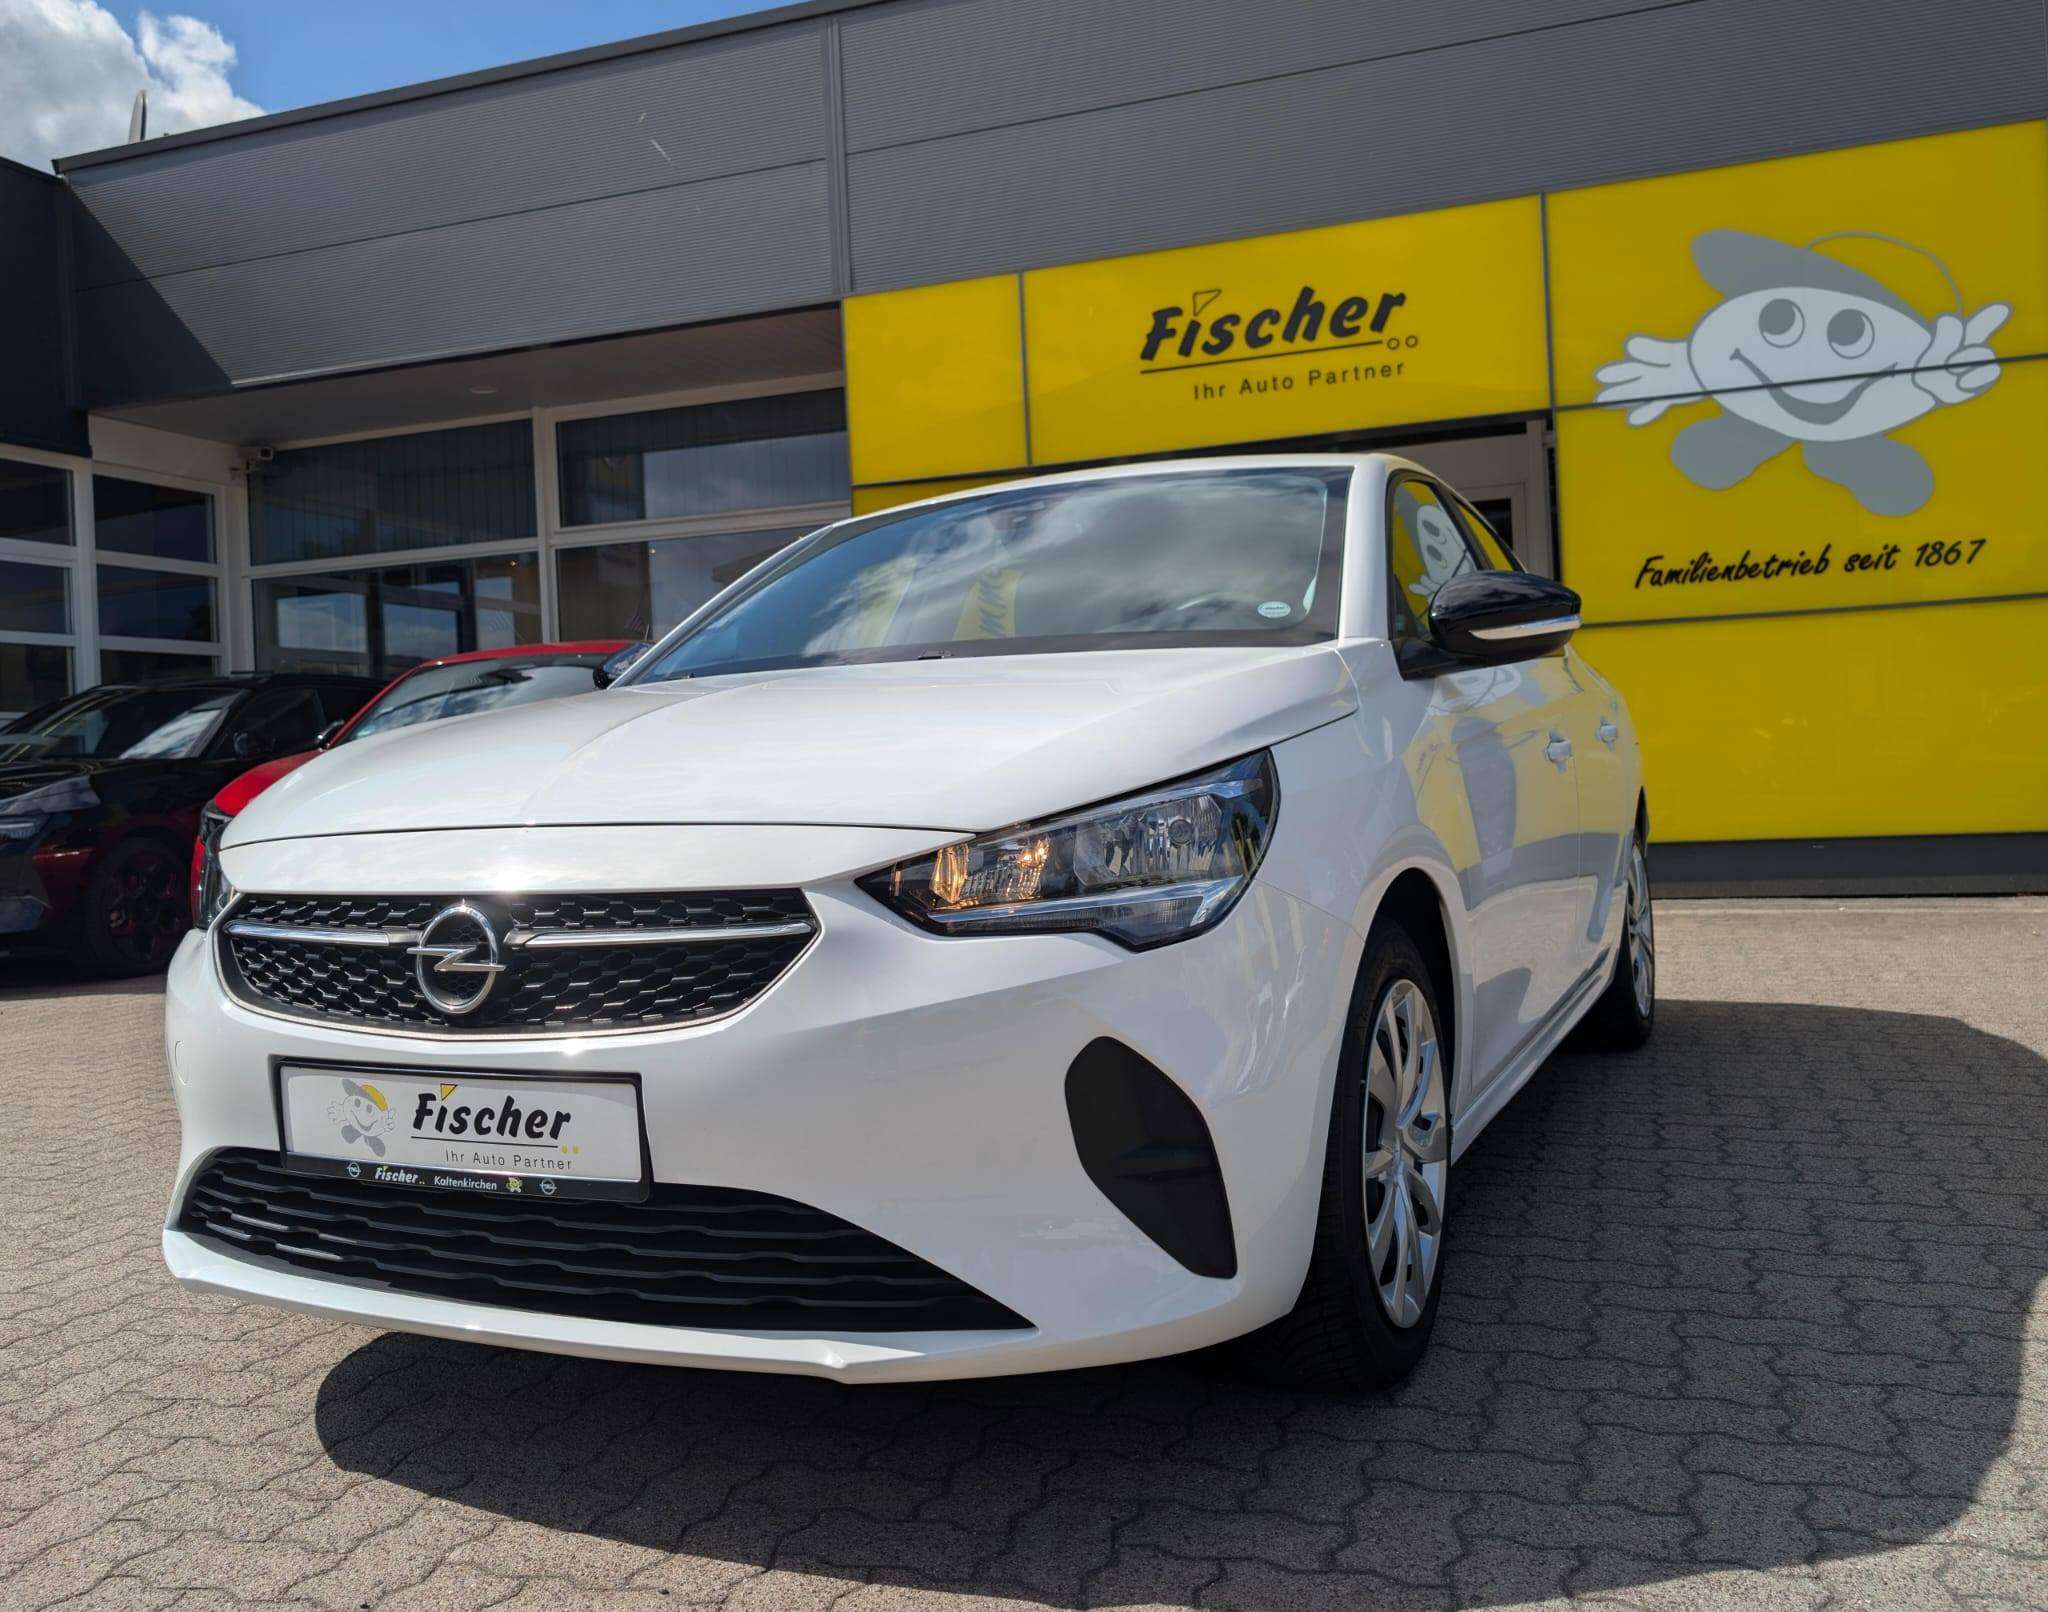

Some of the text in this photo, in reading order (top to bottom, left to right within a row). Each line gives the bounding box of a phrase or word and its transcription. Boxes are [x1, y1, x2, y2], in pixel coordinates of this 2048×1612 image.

[1140, 285, 1406, 361] Fischer
[1193, 363, 1405, 400] Ihr Auto Partner
[1635, 539, 1987, 589] Familienbetrieb seit 1867
[412, 1083, 572, 1140] Fischer
[374, 1166, 498, 1191] Fischer Kaltenkirchen
[445, 1149, 574, 1170] Ihr Auto Partner
